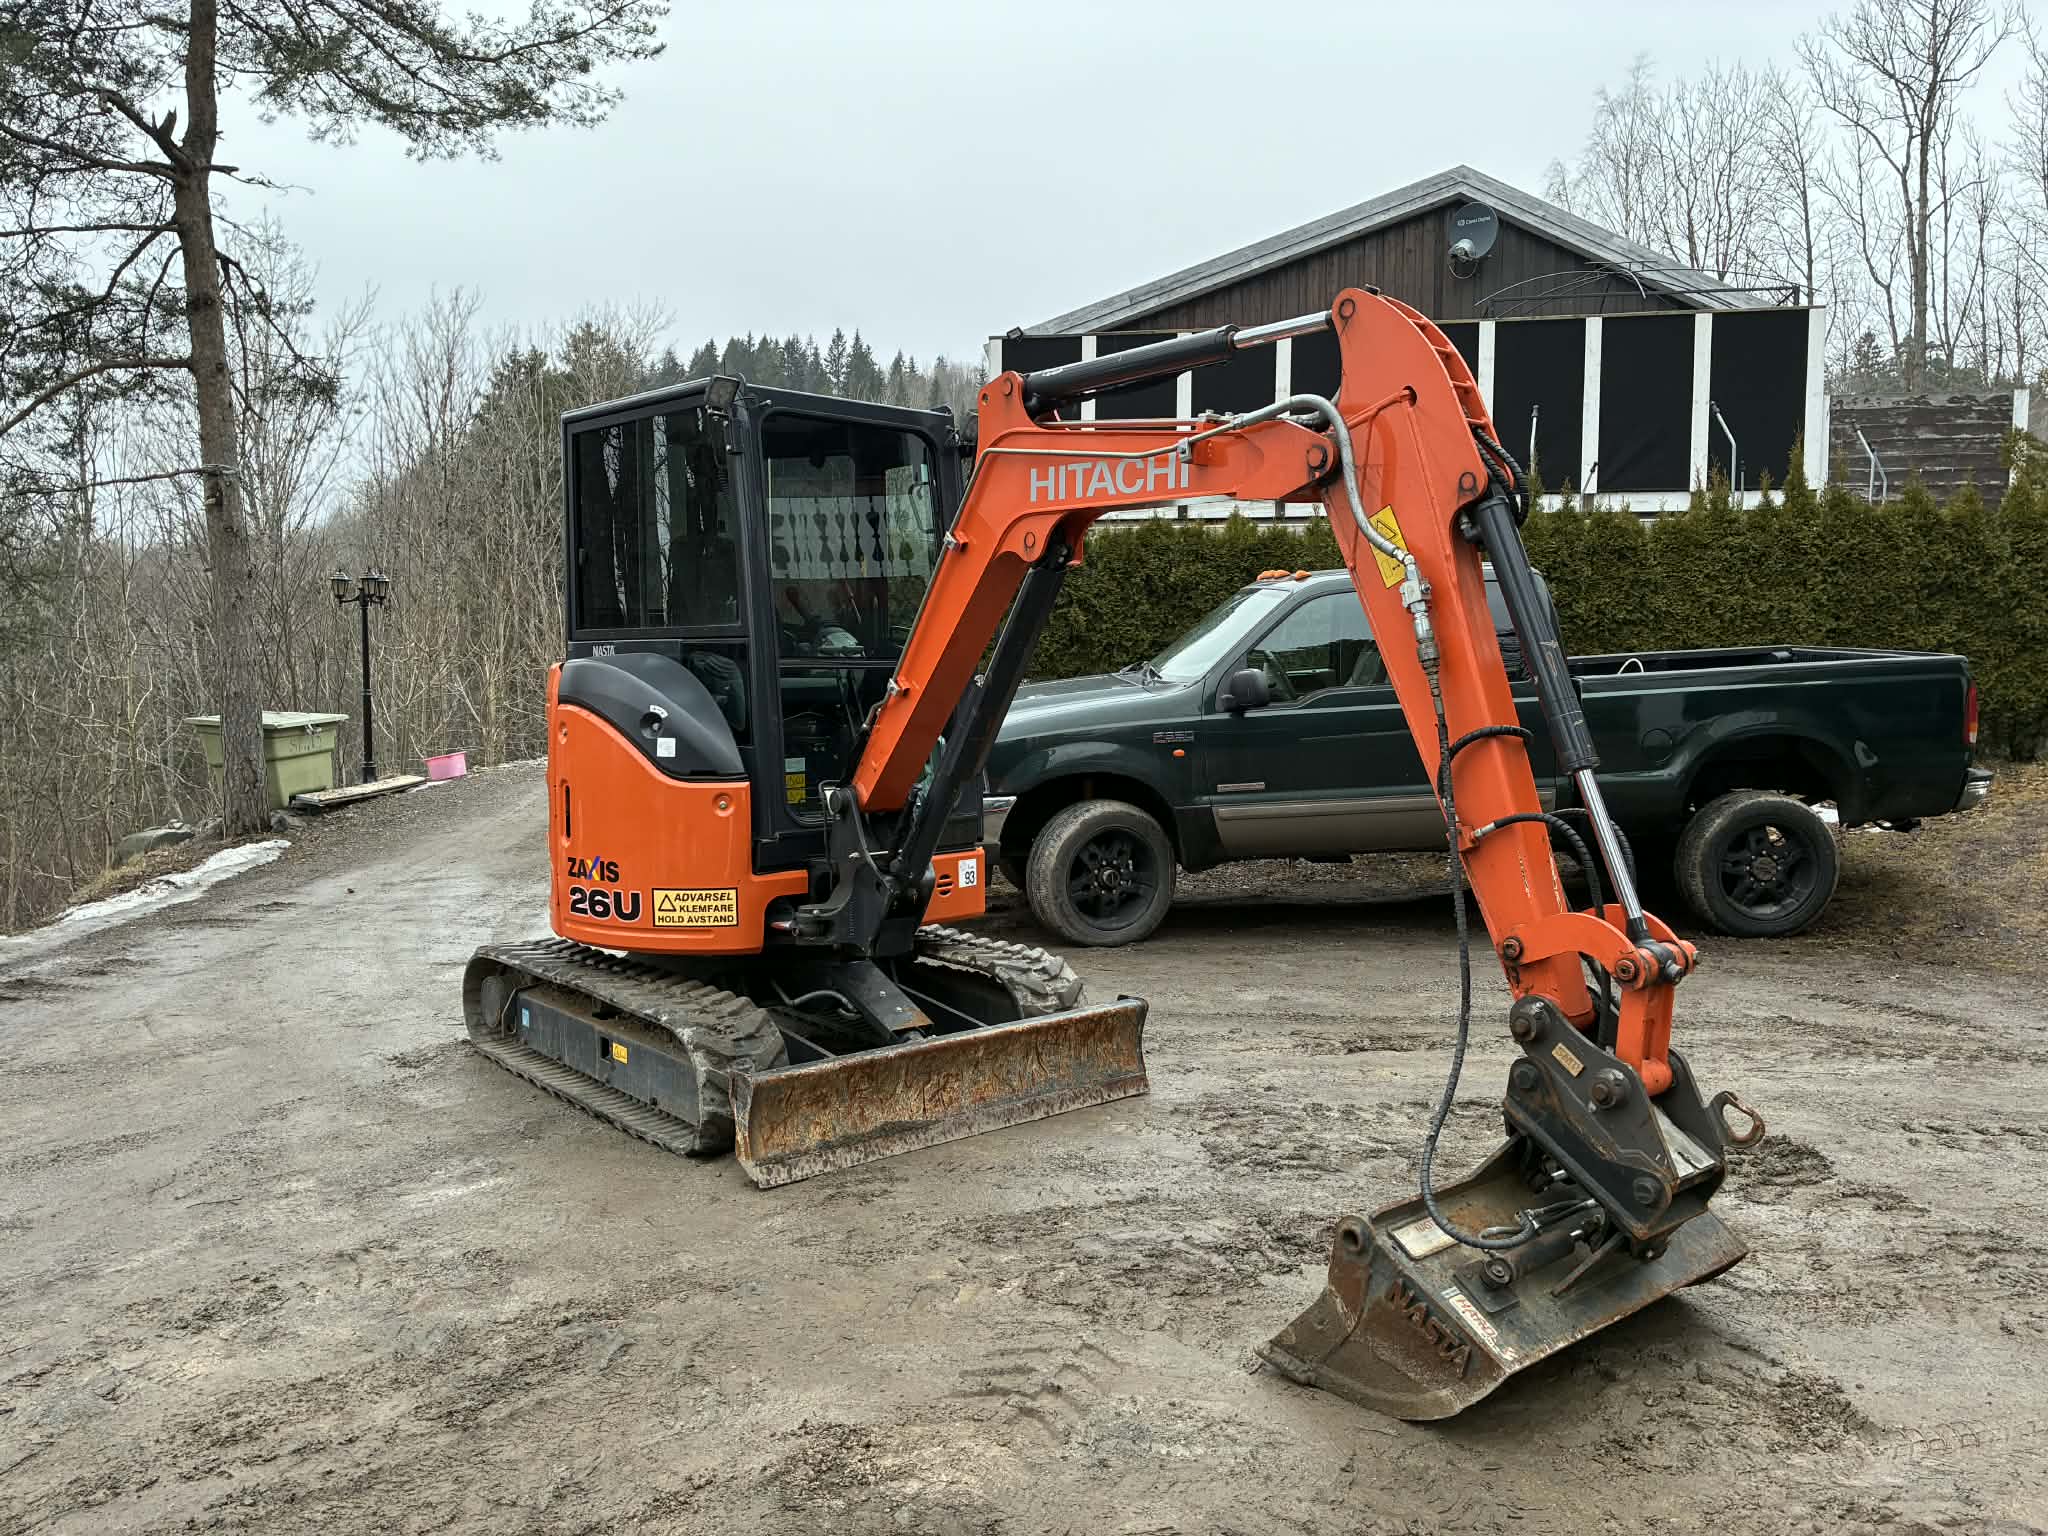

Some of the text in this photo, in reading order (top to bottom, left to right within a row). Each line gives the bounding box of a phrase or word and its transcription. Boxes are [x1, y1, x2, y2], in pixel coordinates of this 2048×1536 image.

[1030, 451, 1189, 502] HITACHI
[592, 645, 616, 657] NASTA
[567, 855, 620, 883] ZAXIS
[965, 871, 976, 885] 93
[674, 892, 733, 901] ADVARSEL
[569, 885, 642, 922] 26U
[679, 903, 734, 913] KLEMFARE
[657, 914, 734, 924] HOLD AVSTAND
